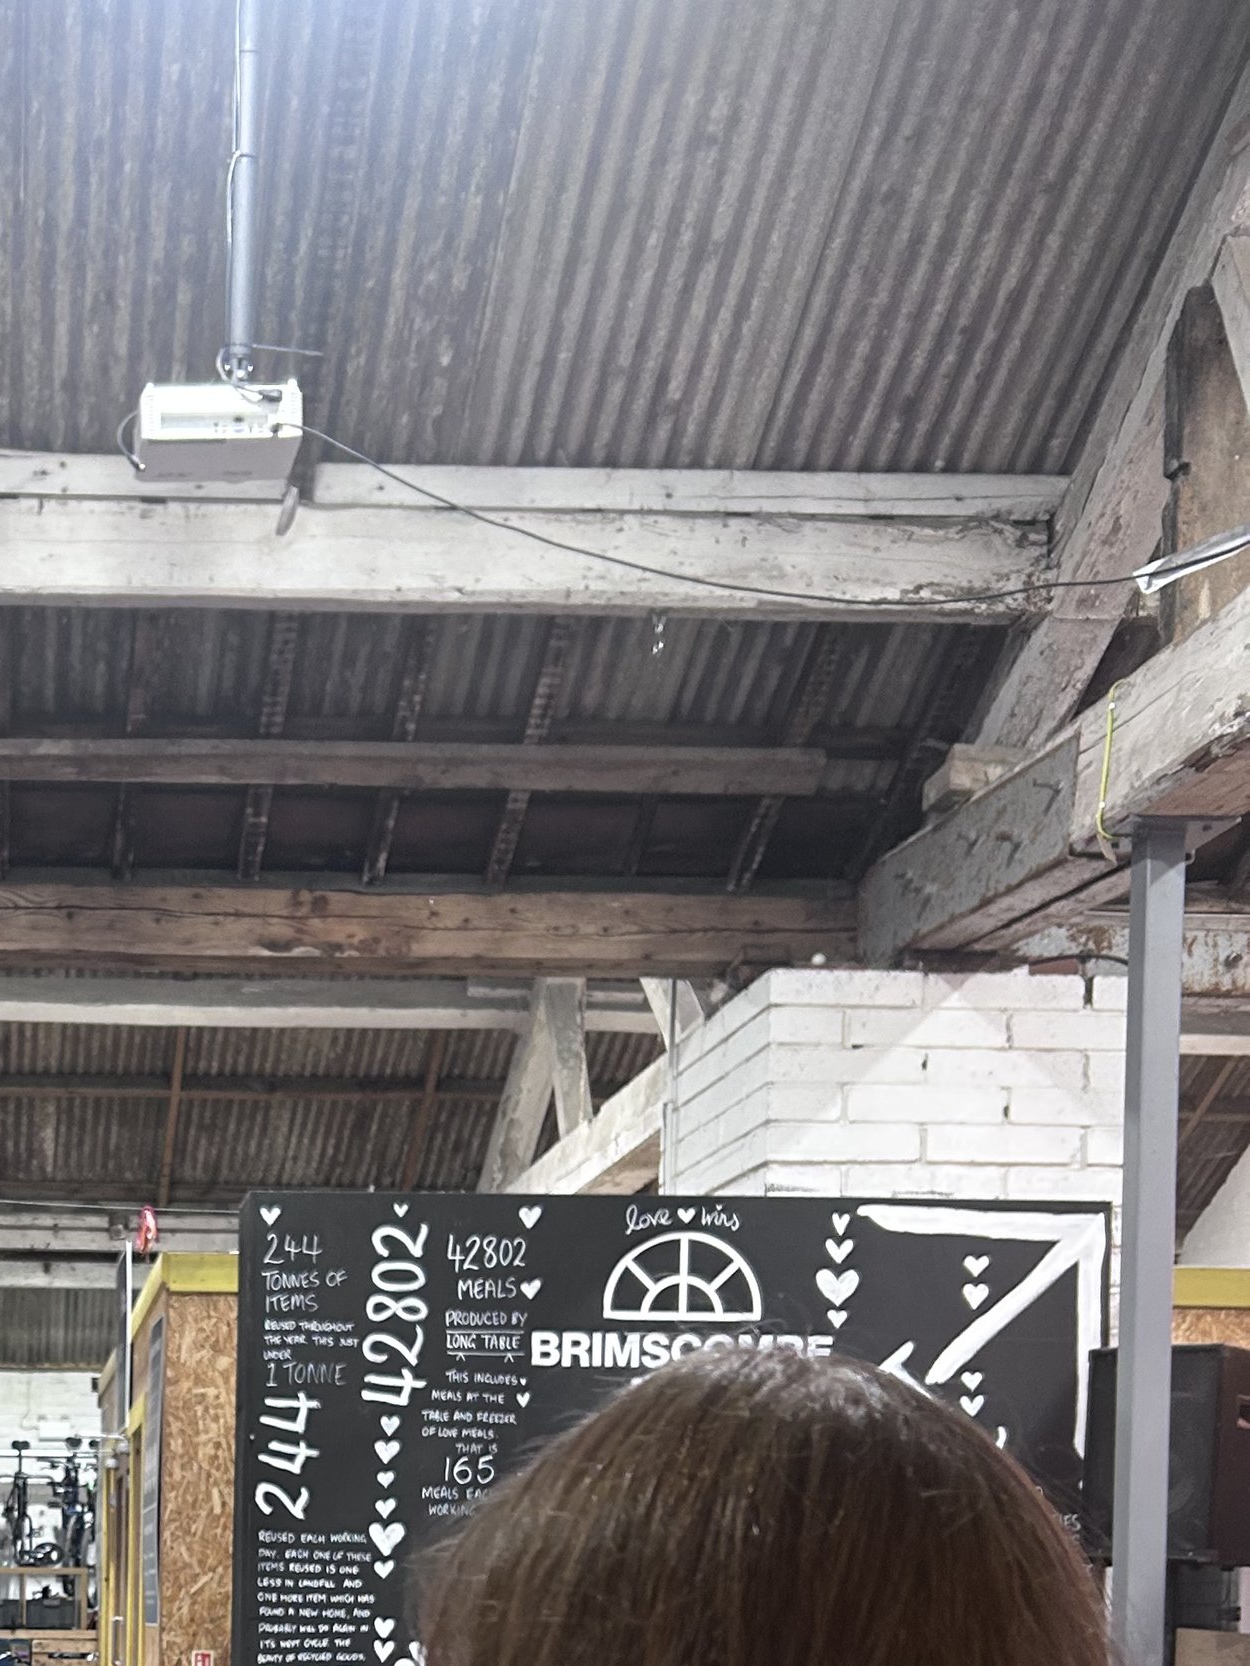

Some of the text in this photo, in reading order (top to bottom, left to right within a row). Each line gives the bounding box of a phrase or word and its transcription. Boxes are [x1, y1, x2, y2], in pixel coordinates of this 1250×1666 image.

[625, 1204, 673, 1235] love
[263, 1233, 323, 1264] 244
[447, 1233, 526, 1273] 42802
[261, 1270, 348, 1291] TONNES OF
[458, 1277, 517, 1300] MEALS
[265, 1294, 318, 1313] ITEMS
[361, 1223, 429, 1406] 42802
[445, 1309, 528, 1327] PRODUCED BY
[264, 1319, 296, 1331] REUSED
[264, 1335, 282, 1345] THE
[312, 1336, 334, 1347] THIS
[446, 1333, 521, 1350] LONG TABLE
[263, 1349, 292, 1361] UNDER
[266, 1361, 347, 1387] 1 TONNE
[445, 1368, 518, 1386] THIS INCLUDES
[431, 1389, 505, 1404] MEALS AT THE
[454, 1410, 473, 1422] AND
[476, 1411, 517, 1425] FREEZER
[421, 1427, 436, 1437] OF
[438, 1427, 458, 1438] LOVE
[255, 1390, 321, 1519] 244
[456, 1443, 498, 1454] THAT IS
[445, 1454, 494, 1485] 165
[421, 1486, 459, 1500] MEALS
[258, 1529, 367, 1544] REUSED EACH WORKING
[285, 1549, 309, 1560] EACH
[313, 1551, 330, 1561] ONE
[346, 1552, 371, 1562] THESE
[258, 1562, 359, 1575] ITEMS REUSED IS ONE
[257, 1577, 282, 1587] LESS
[285, 1579, 293, 1588] IN
[343, 1579, 362, 1588] AND
[257, 1592, 277, 1602] ONE
[280, 1593, 303, 1603] MORE
[306, 1594, 326, 1603] ITEM
[288, 1607, 294, 1616] A
[299, 1608, 318, 1617] NEW
[353, 1608, 370, 1617] AND
[334, 1638, 351, 1647] THE
